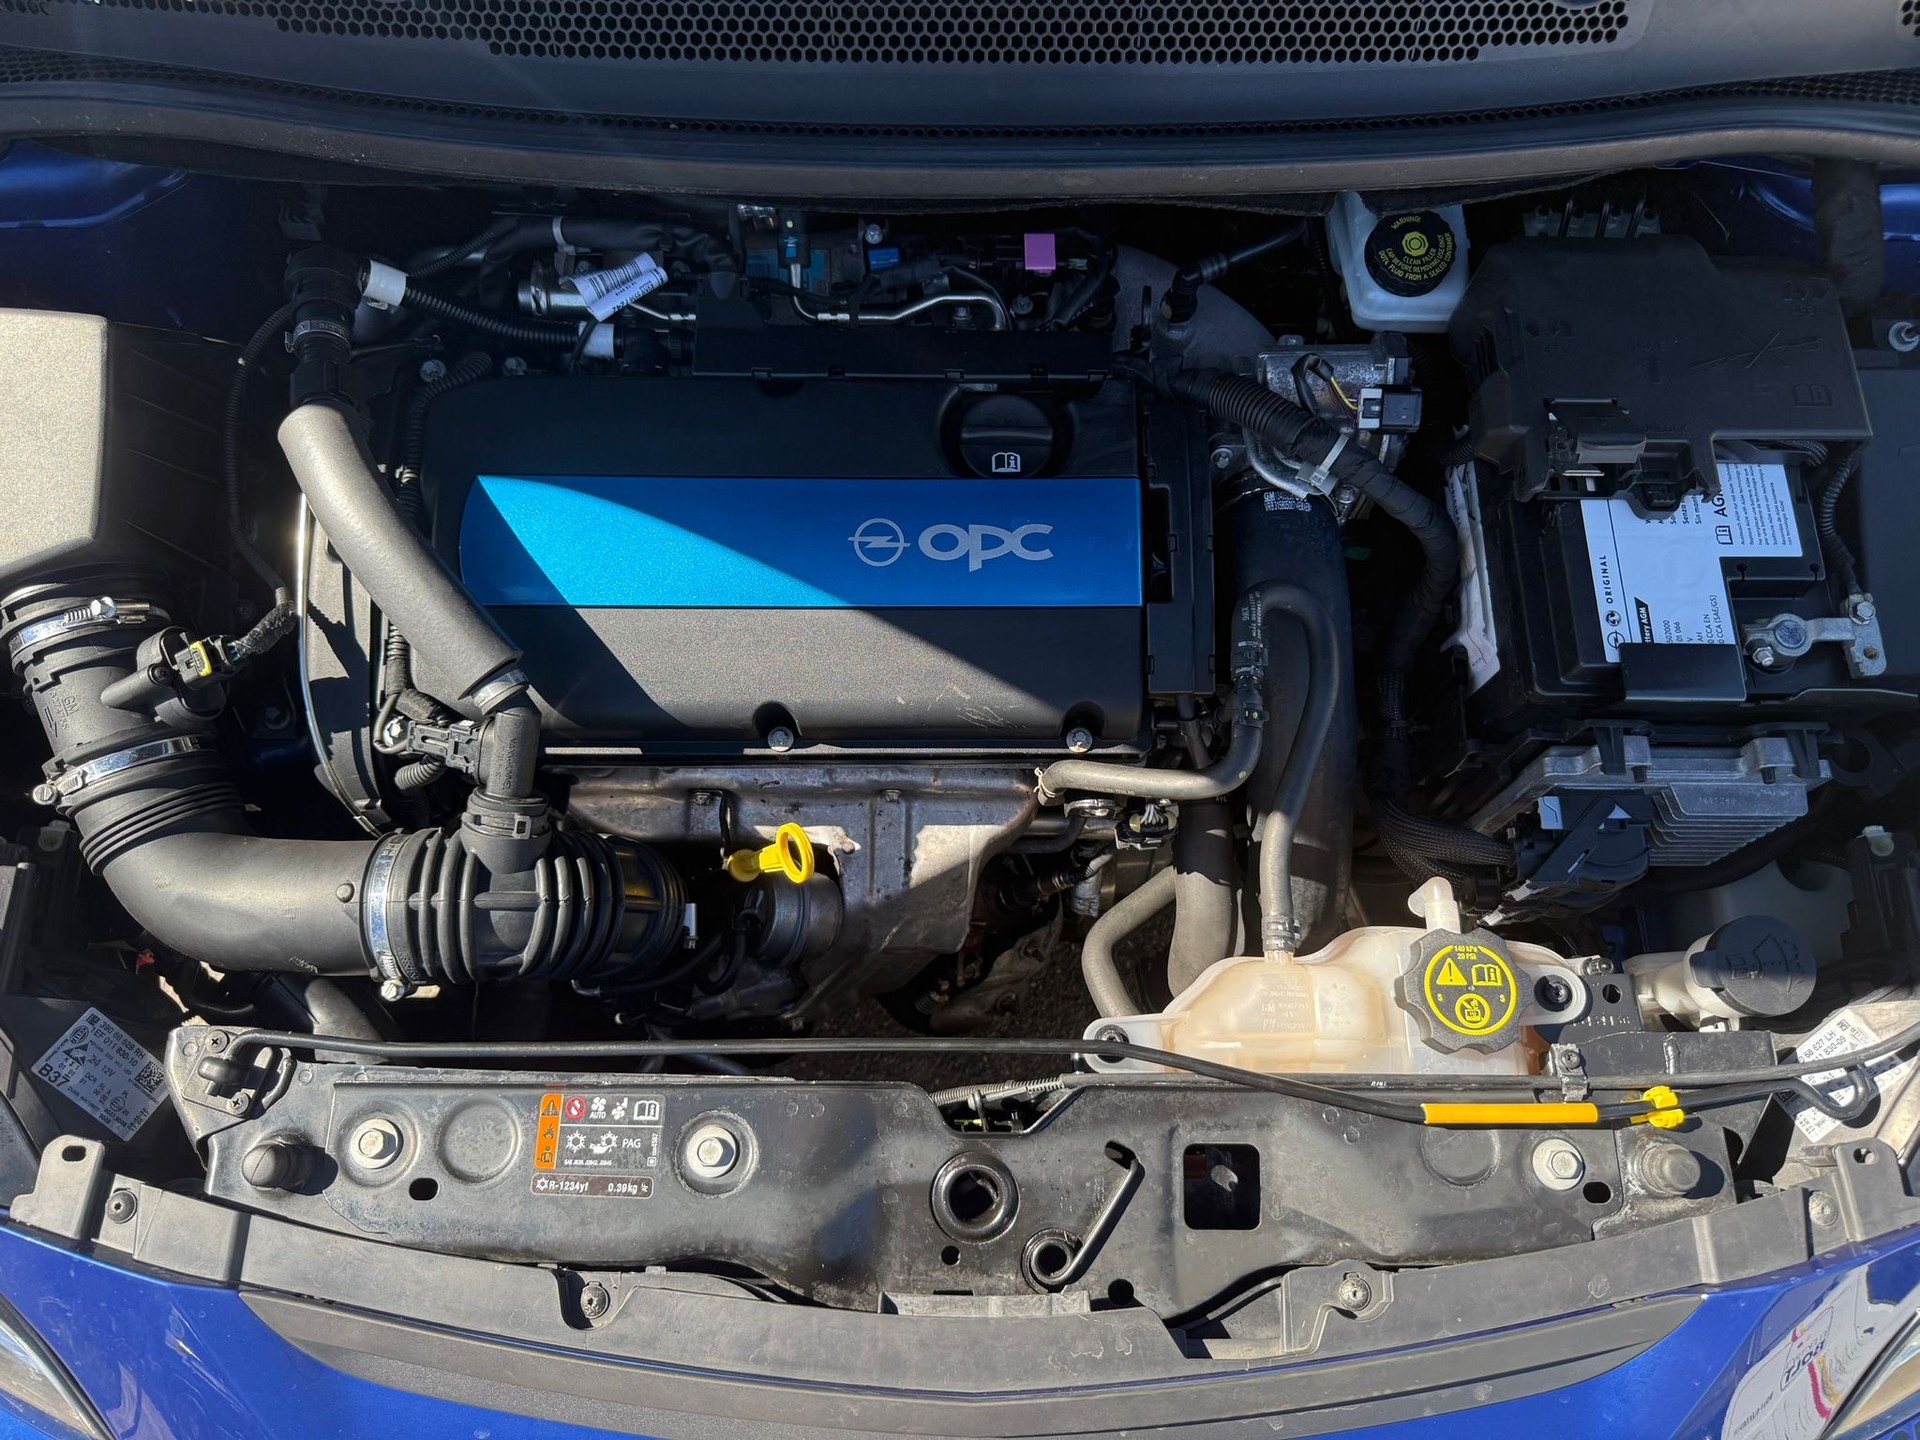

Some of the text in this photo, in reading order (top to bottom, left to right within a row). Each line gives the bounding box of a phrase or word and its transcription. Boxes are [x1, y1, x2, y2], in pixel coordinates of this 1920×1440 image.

[1391, 215, 1421, 230] WARNING!
[1386, 248, 1396, 259] CAP
[1392, 257, 1413, 272] BEFORE
[1413, 257, 1440, 272] REMOVING
[1437, 248, 1445, 259] USE
[1388, 264, 1404, 277] FLUID
[1429, 261, 1447, 278] SEALED
[1444, 232, 1453, 262] CONTAINER
[1403, 248, 1437, 265] CLEAN FILLER
[1599, 555, 1614, 604] ORIGINAL
[1638, 607, 1648, 623] AGM
[1709, 595, 1721, 624] (SAE/GS)
[1703, 614, 1711, 624] EN
[1705, 624, 1714, 639] CCA
[1715, 624, 1724, 639] CCA
[104, 1037, 117, 1049] 011
[116, 1047, 138, 1067] 830-10
[1804, 1030, 1836, 1058] 68 627 LH
[1823, 1035, 1847, 1056] 830-09
[133, 1048, 146, 1059] RH
[38, 1063, 70, 1087] B37
[101, 1065, 116, 1077] 12V
[589, 1111, 606, 1119] AUTO
[622, 1138, 641, 1149] PAG
[549, 1180, 589, 1192] R-1234yf
